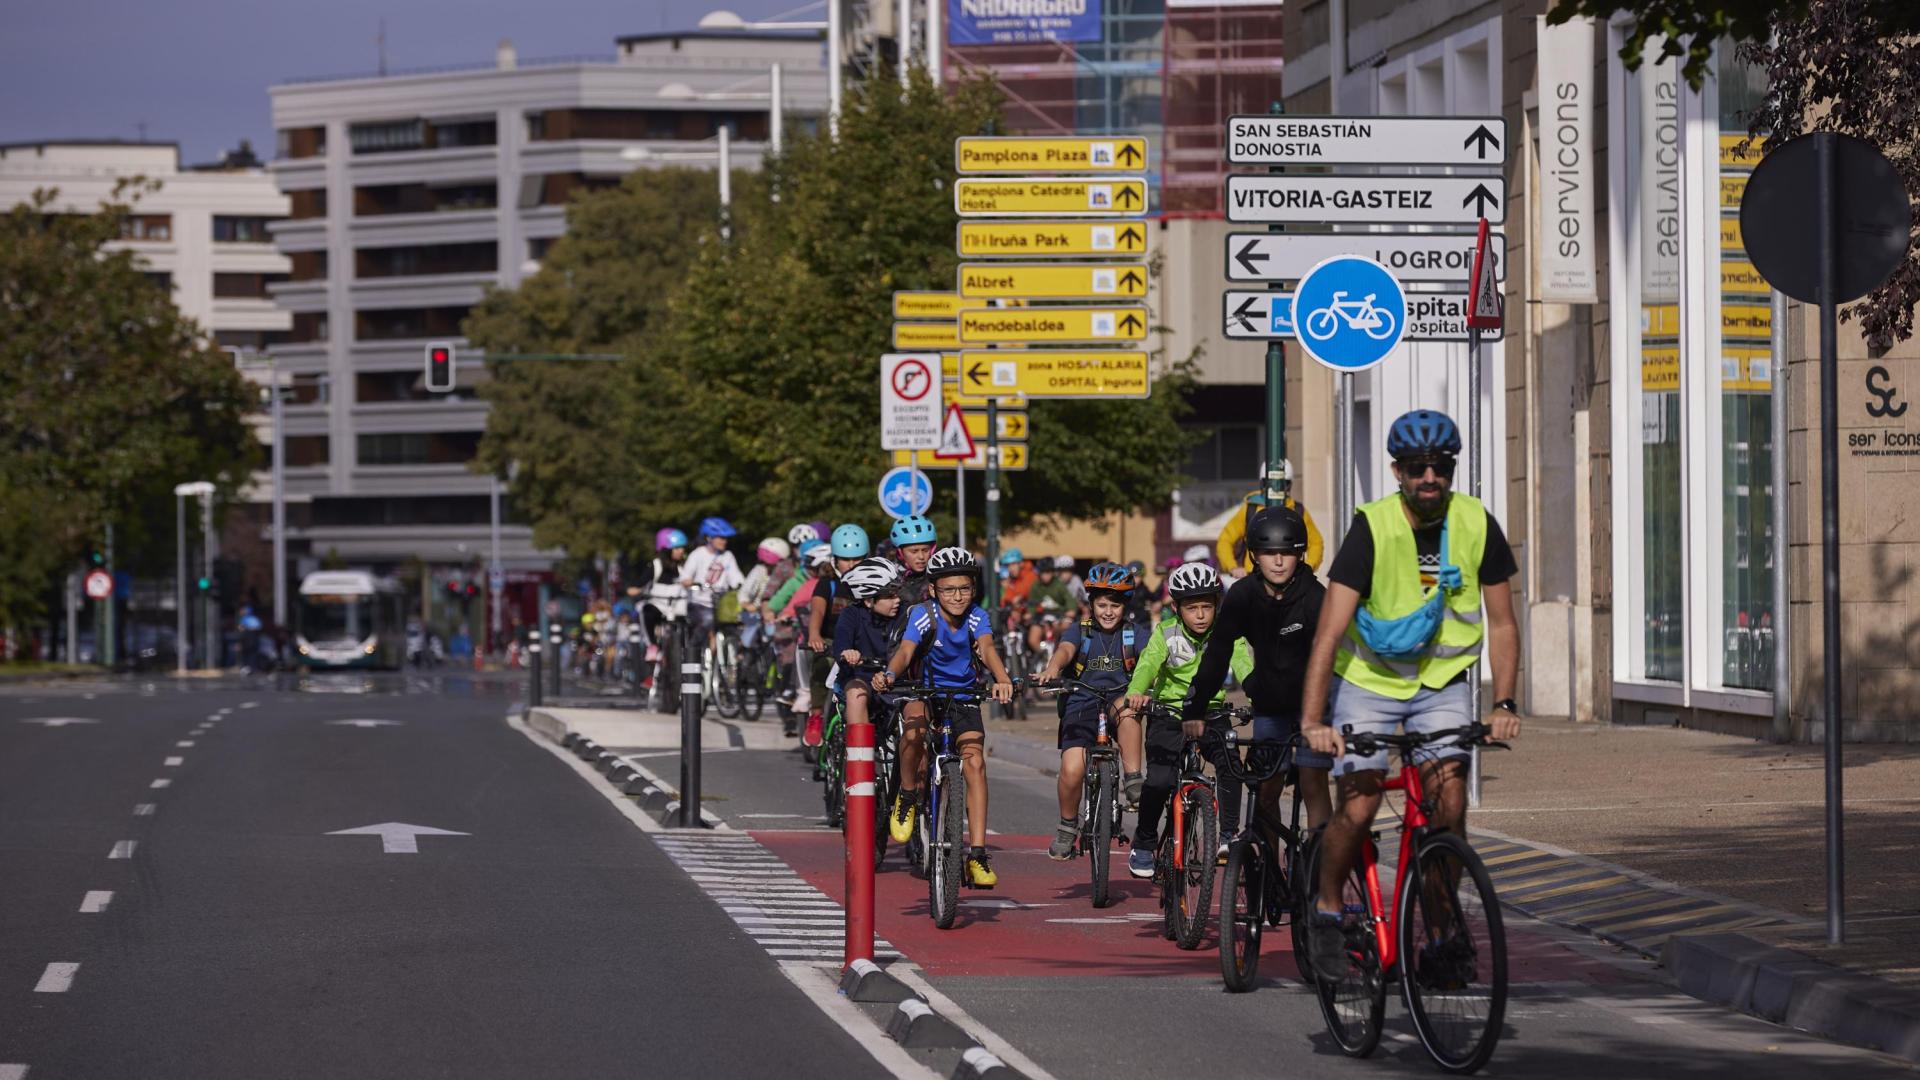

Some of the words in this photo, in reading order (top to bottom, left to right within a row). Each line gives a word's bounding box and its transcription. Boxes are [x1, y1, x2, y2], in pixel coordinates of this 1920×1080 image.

[1235, 124, 1271, 138] SAN
[1276, 121, 1372, 138] SEBASTIÁN
[963, 149, 1039, 165] Pamplona
[1046, 148, 1088, 161] Plaza
[1234, 143, 1322, 156] DONOSTIA
[1552, 82, 1580, 259] servicons
[962, 185, 1024, 198] Pamplona
[1030, 184, 1086, 197] Catedral
[962, 199, 997, 209] Hotel
[1234, 189, 1433, 209] VITORIA-GASTEIZ
[1035, 233, 1070, 247] Park
[1375, 249, 1499, 269] LOGRO
[965, 275, 1014, 289] Albret
[964, 319, 1066, 333] Mendebaldea
[1048, 377, 1097, 388] OSPITAL
